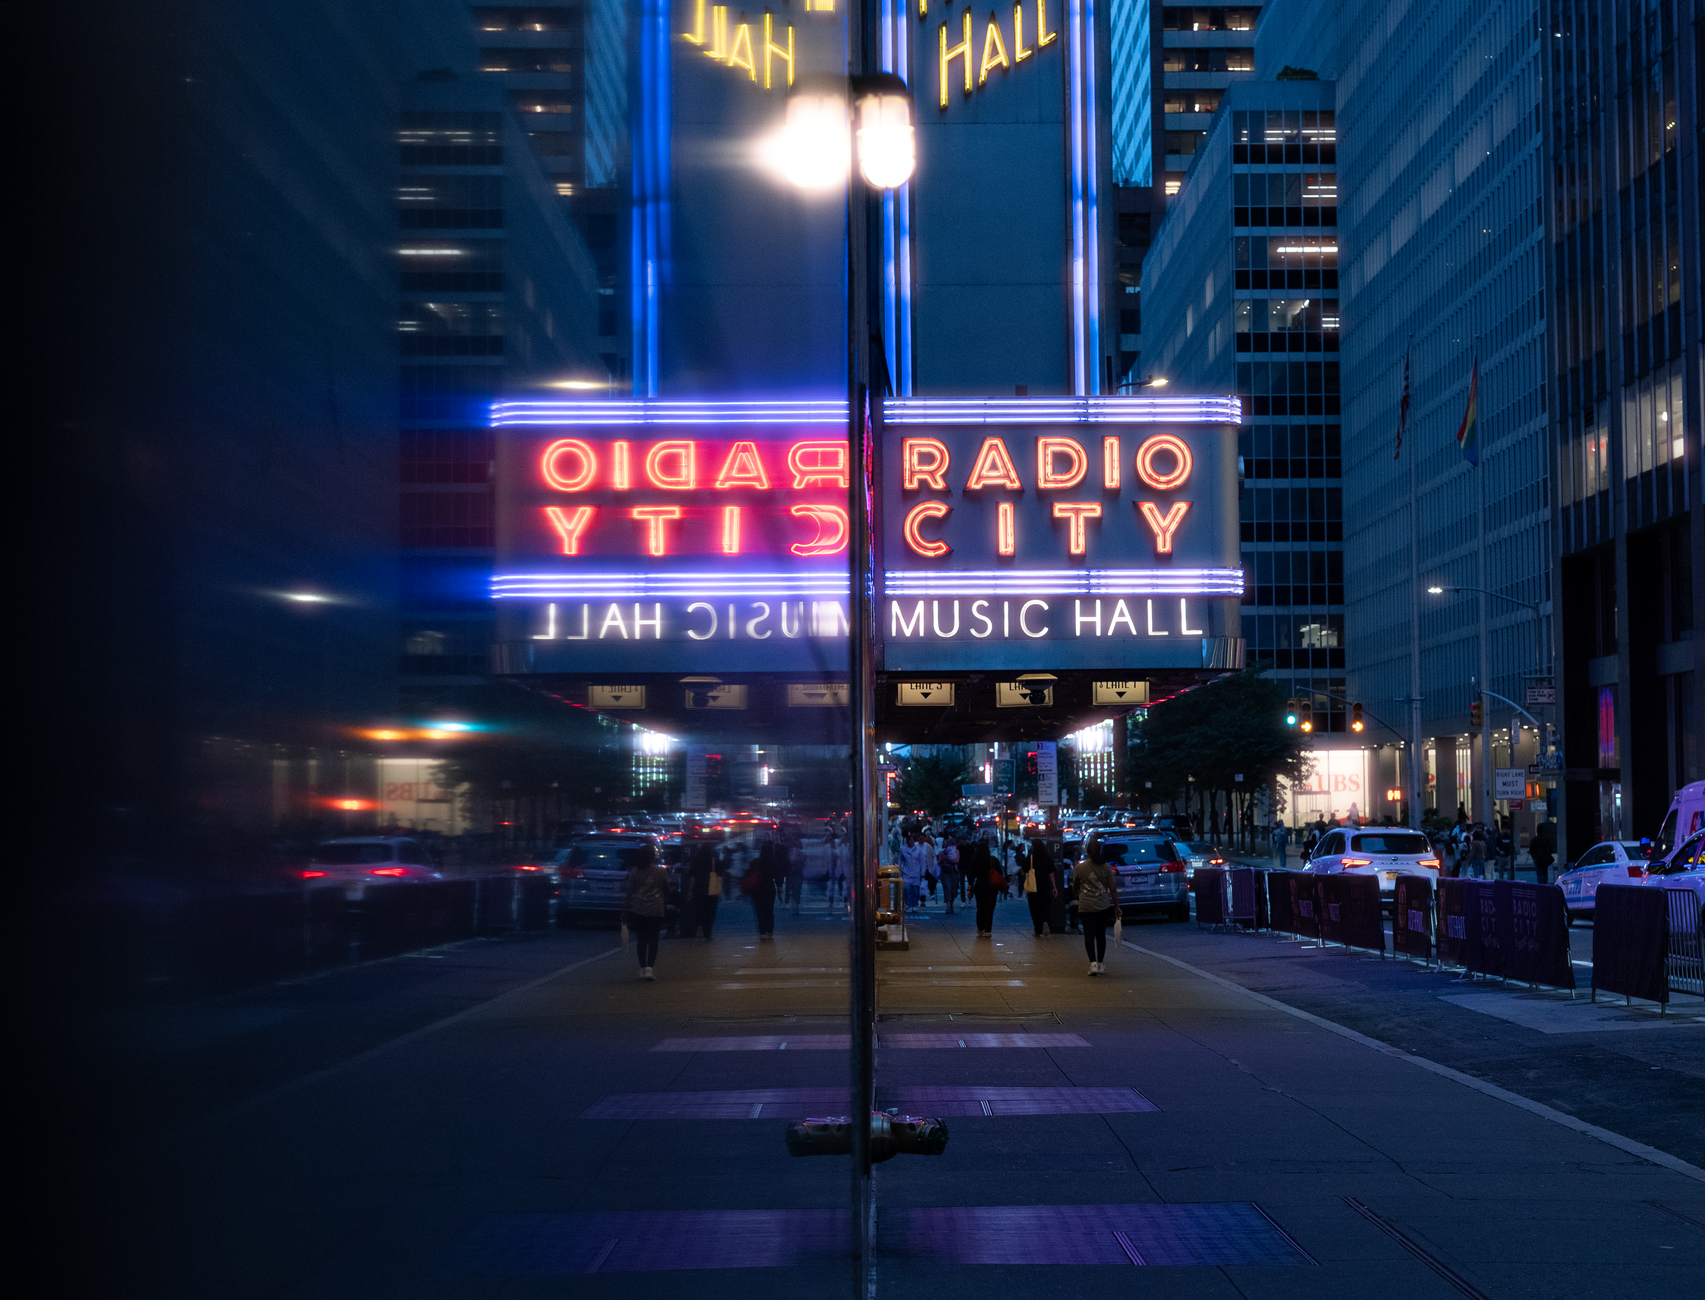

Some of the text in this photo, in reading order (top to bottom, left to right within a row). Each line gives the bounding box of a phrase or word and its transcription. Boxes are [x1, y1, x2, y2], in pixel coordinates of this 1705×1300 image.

[938, 0, 1058, 111] HALL
[902, 433, 1194, 492] RADIO
[902, 499, 1194, 558] CITY
[890, 598, 1204, 638] MUSIC HALL
[1316, 773, 1361, 792] UBS
[1480, 898, 1496, 915] RAD
[1512, 899, 1537, 918] RADIO
[1481, 916, 1496, 932] CIT
[1513, 917, 1538, 936] CITY
